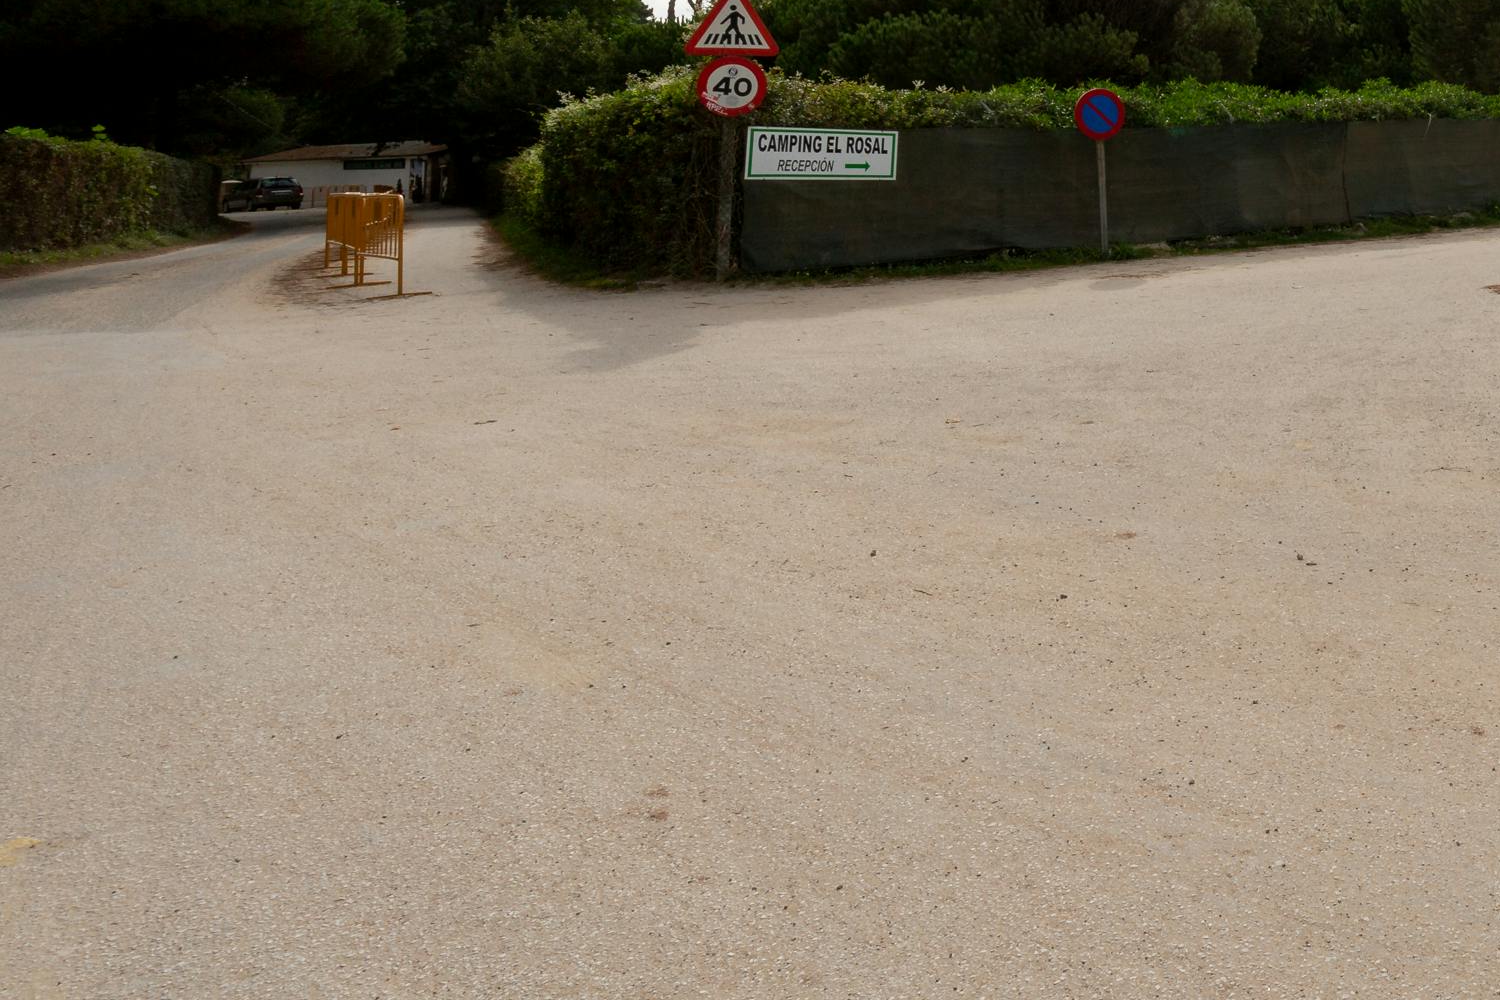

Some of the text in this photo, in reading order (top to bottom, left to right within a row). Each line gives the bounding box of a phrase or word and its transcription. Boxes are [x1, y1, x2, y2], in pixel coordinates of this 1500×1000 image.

[712, 77, 752, 97] 40
[758, 134, 888, 155] CAMPING EL ROSAL
[777, 157, 834, 172] RECEPCIÓN
